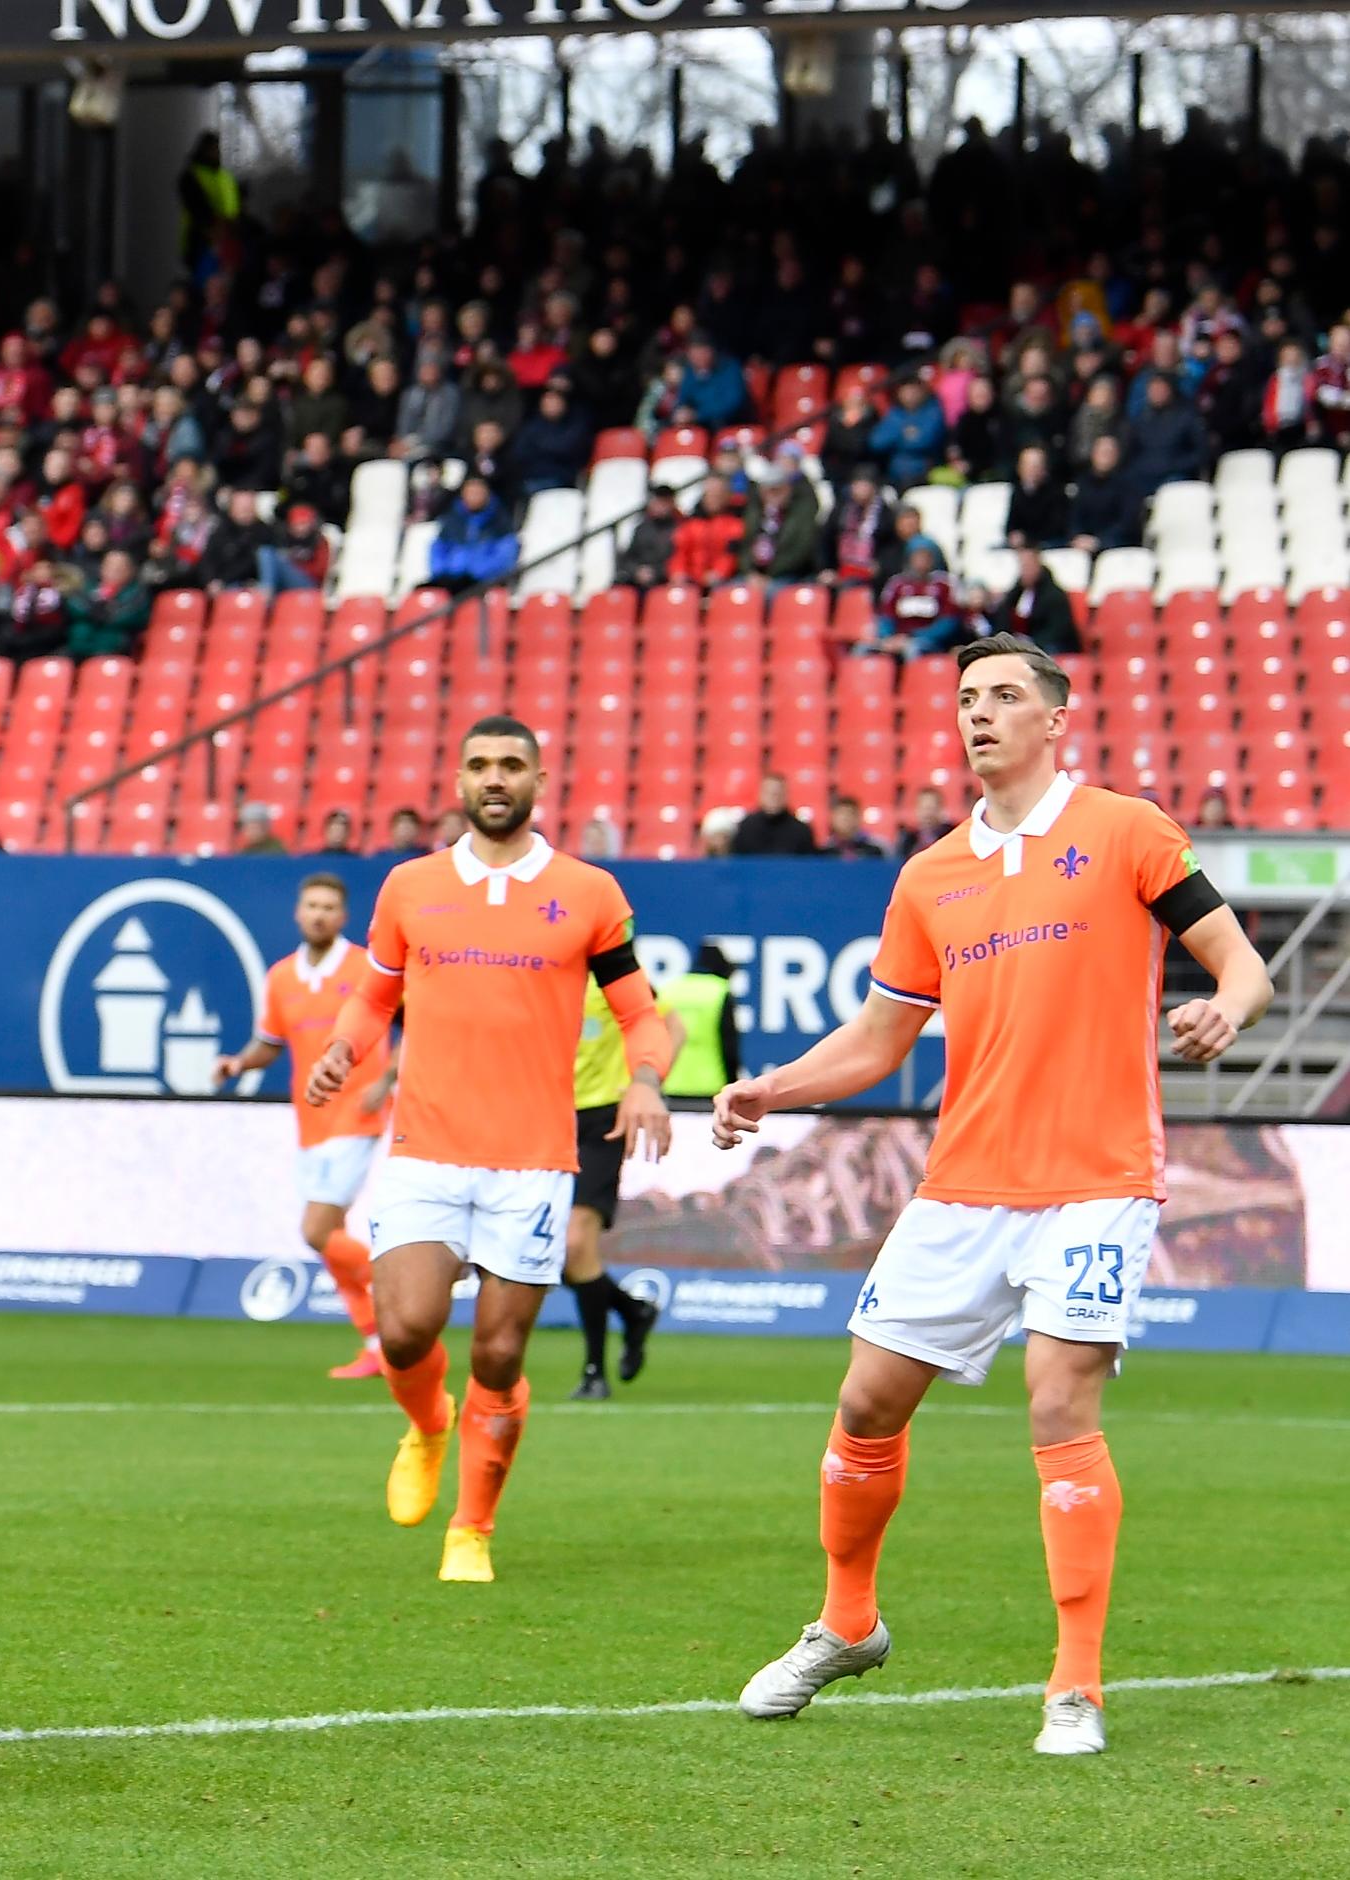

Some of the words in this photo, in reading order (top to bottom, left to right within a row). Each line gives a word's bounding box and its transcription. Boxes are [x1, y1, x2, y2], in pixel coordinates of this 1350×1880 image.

[436, 946, 544, 971] software
[960, 922, 1069, 965] software
[1072, 922, 1089, 932] AG
[1064, 1243, 1124, 1305] 23
